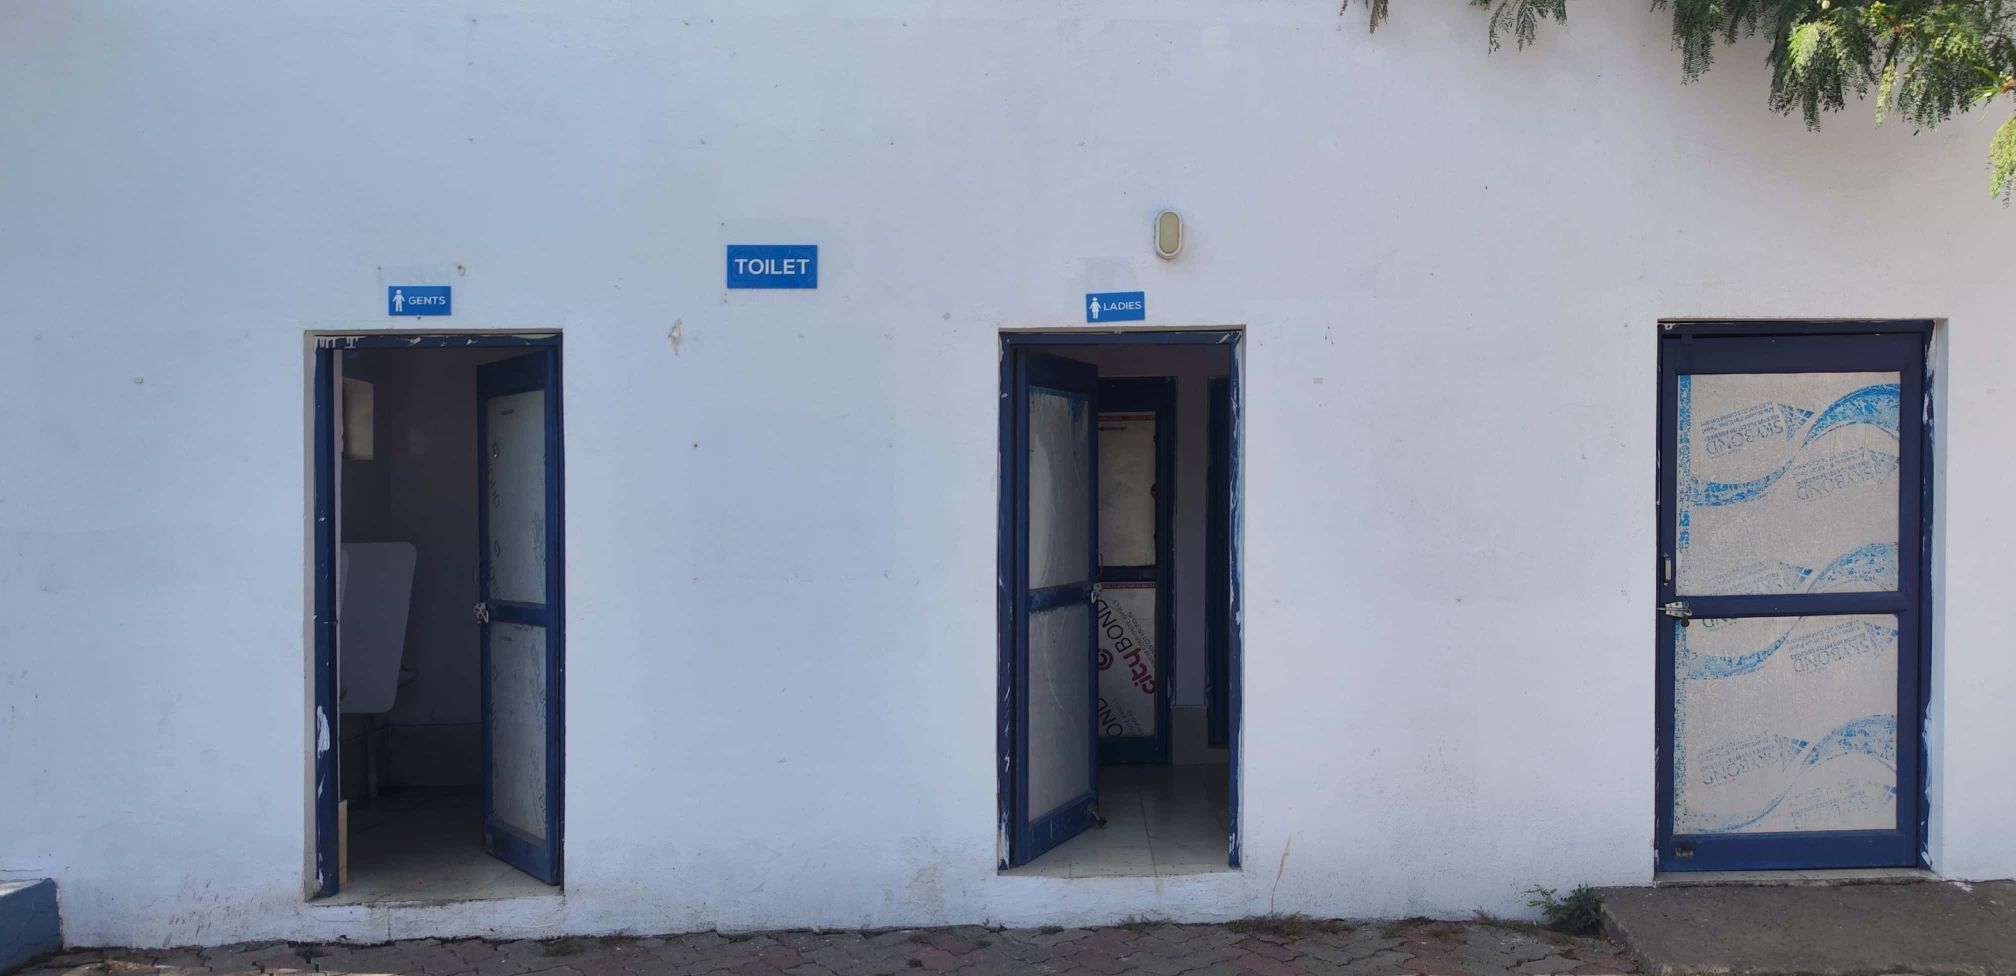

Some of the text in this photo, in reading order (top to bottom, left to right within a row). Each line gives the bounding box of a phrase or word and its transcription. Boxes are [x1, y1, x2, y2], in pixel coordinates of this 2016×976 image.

[734, 259, 810, 275] TOILET
[408, 296, 446, 305] GENTS
[1103, 301, 1142, 311] LADIES
